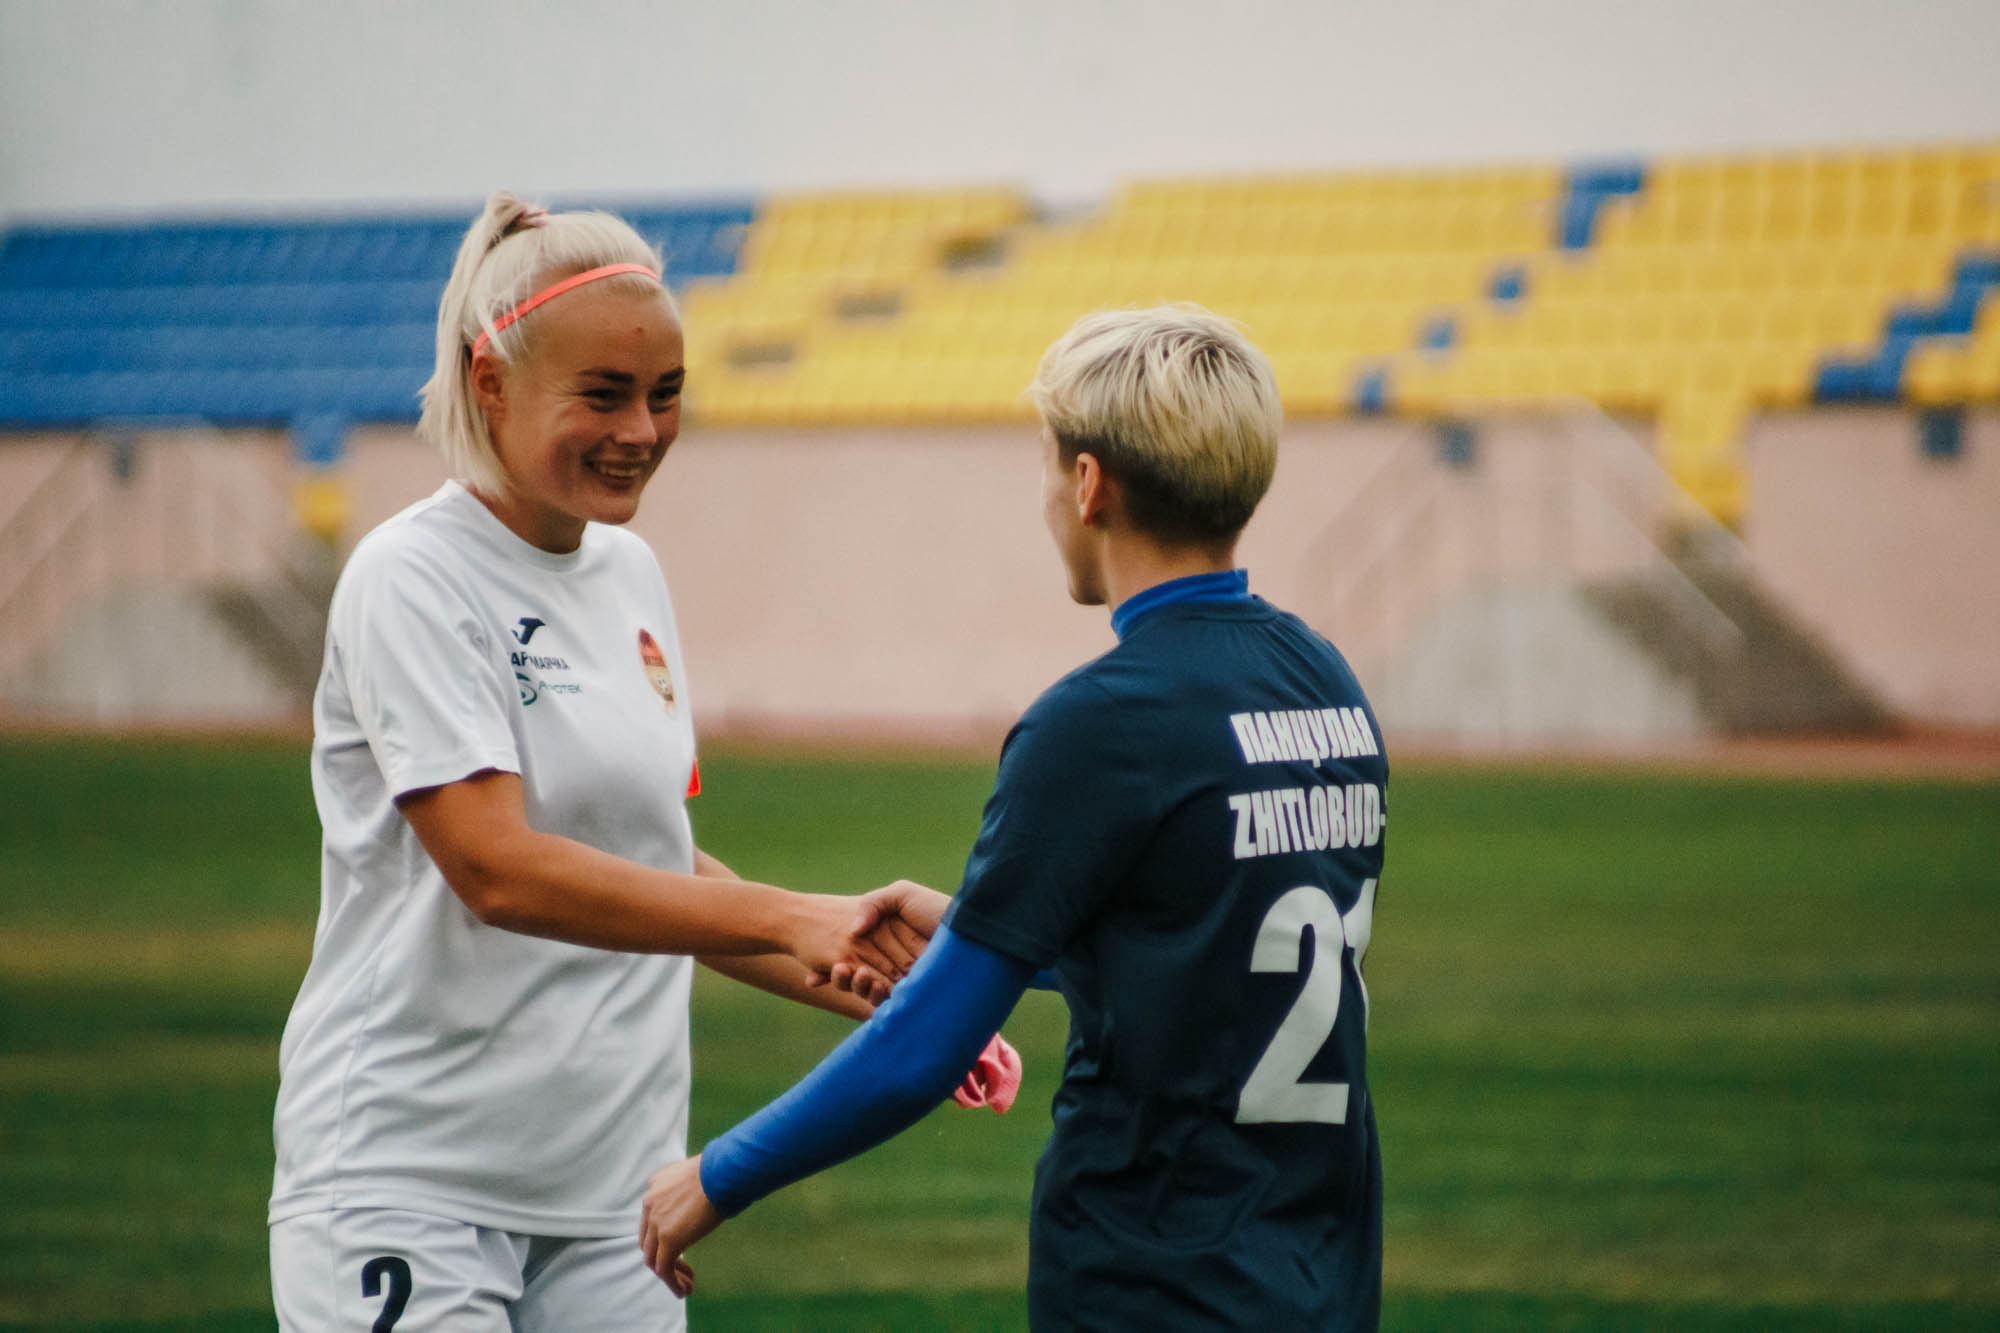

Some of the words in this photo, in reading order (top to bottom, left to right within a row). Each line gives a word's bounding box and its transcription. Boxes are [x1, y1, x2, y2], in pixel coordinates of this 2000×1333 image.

[1229, 707, 1379, 768] ПАНЦУЛАЯ
[1228, 783, 1387, 860] ZHITLOBUD-
[361, 1256, 412, 1333] 2
